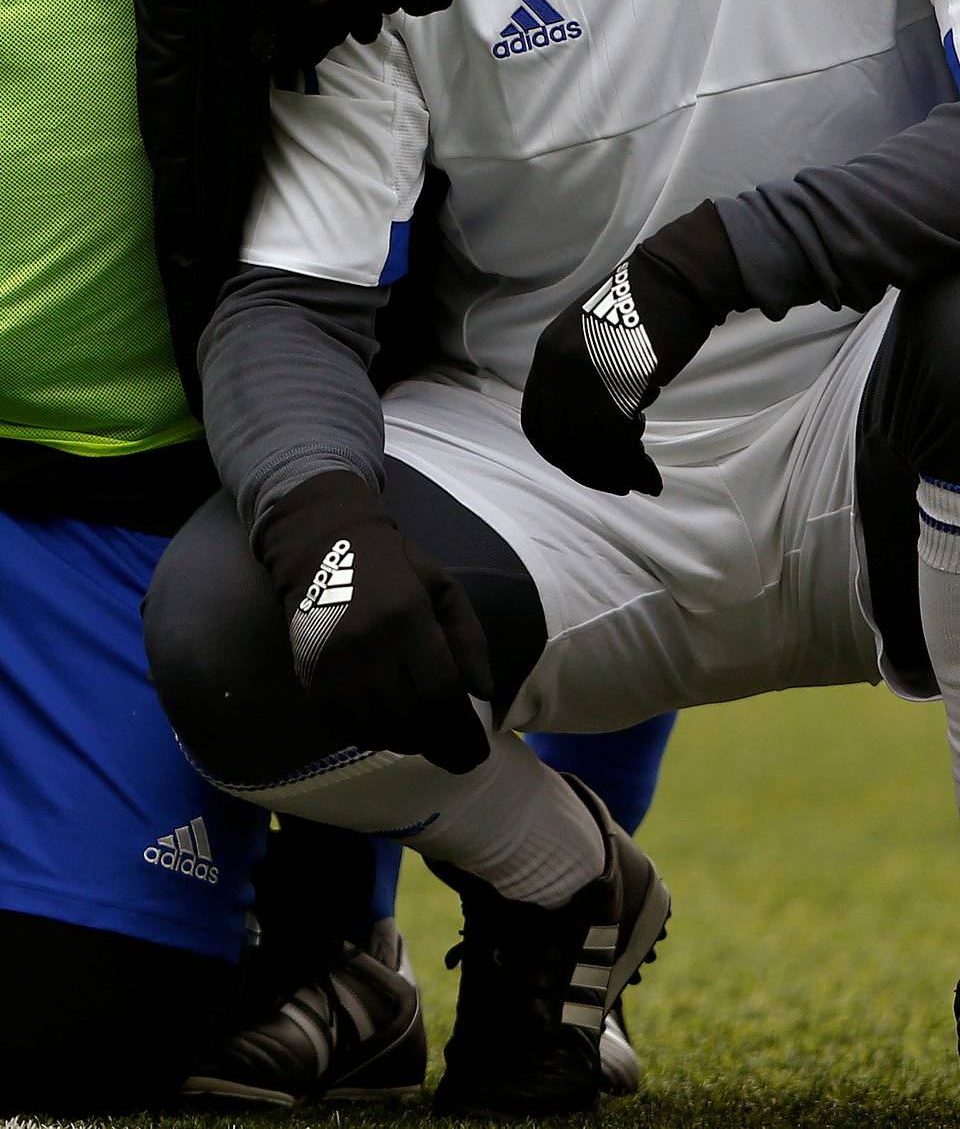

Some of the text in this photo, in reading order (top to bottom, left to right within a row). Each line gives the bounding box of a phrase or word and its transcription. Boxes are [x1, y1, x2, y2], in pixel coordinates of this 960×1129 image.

[492, 21, 583, 59] adidas
[300, 539, 351, 612] adidas
[144, 846, 219, 884] adidas
